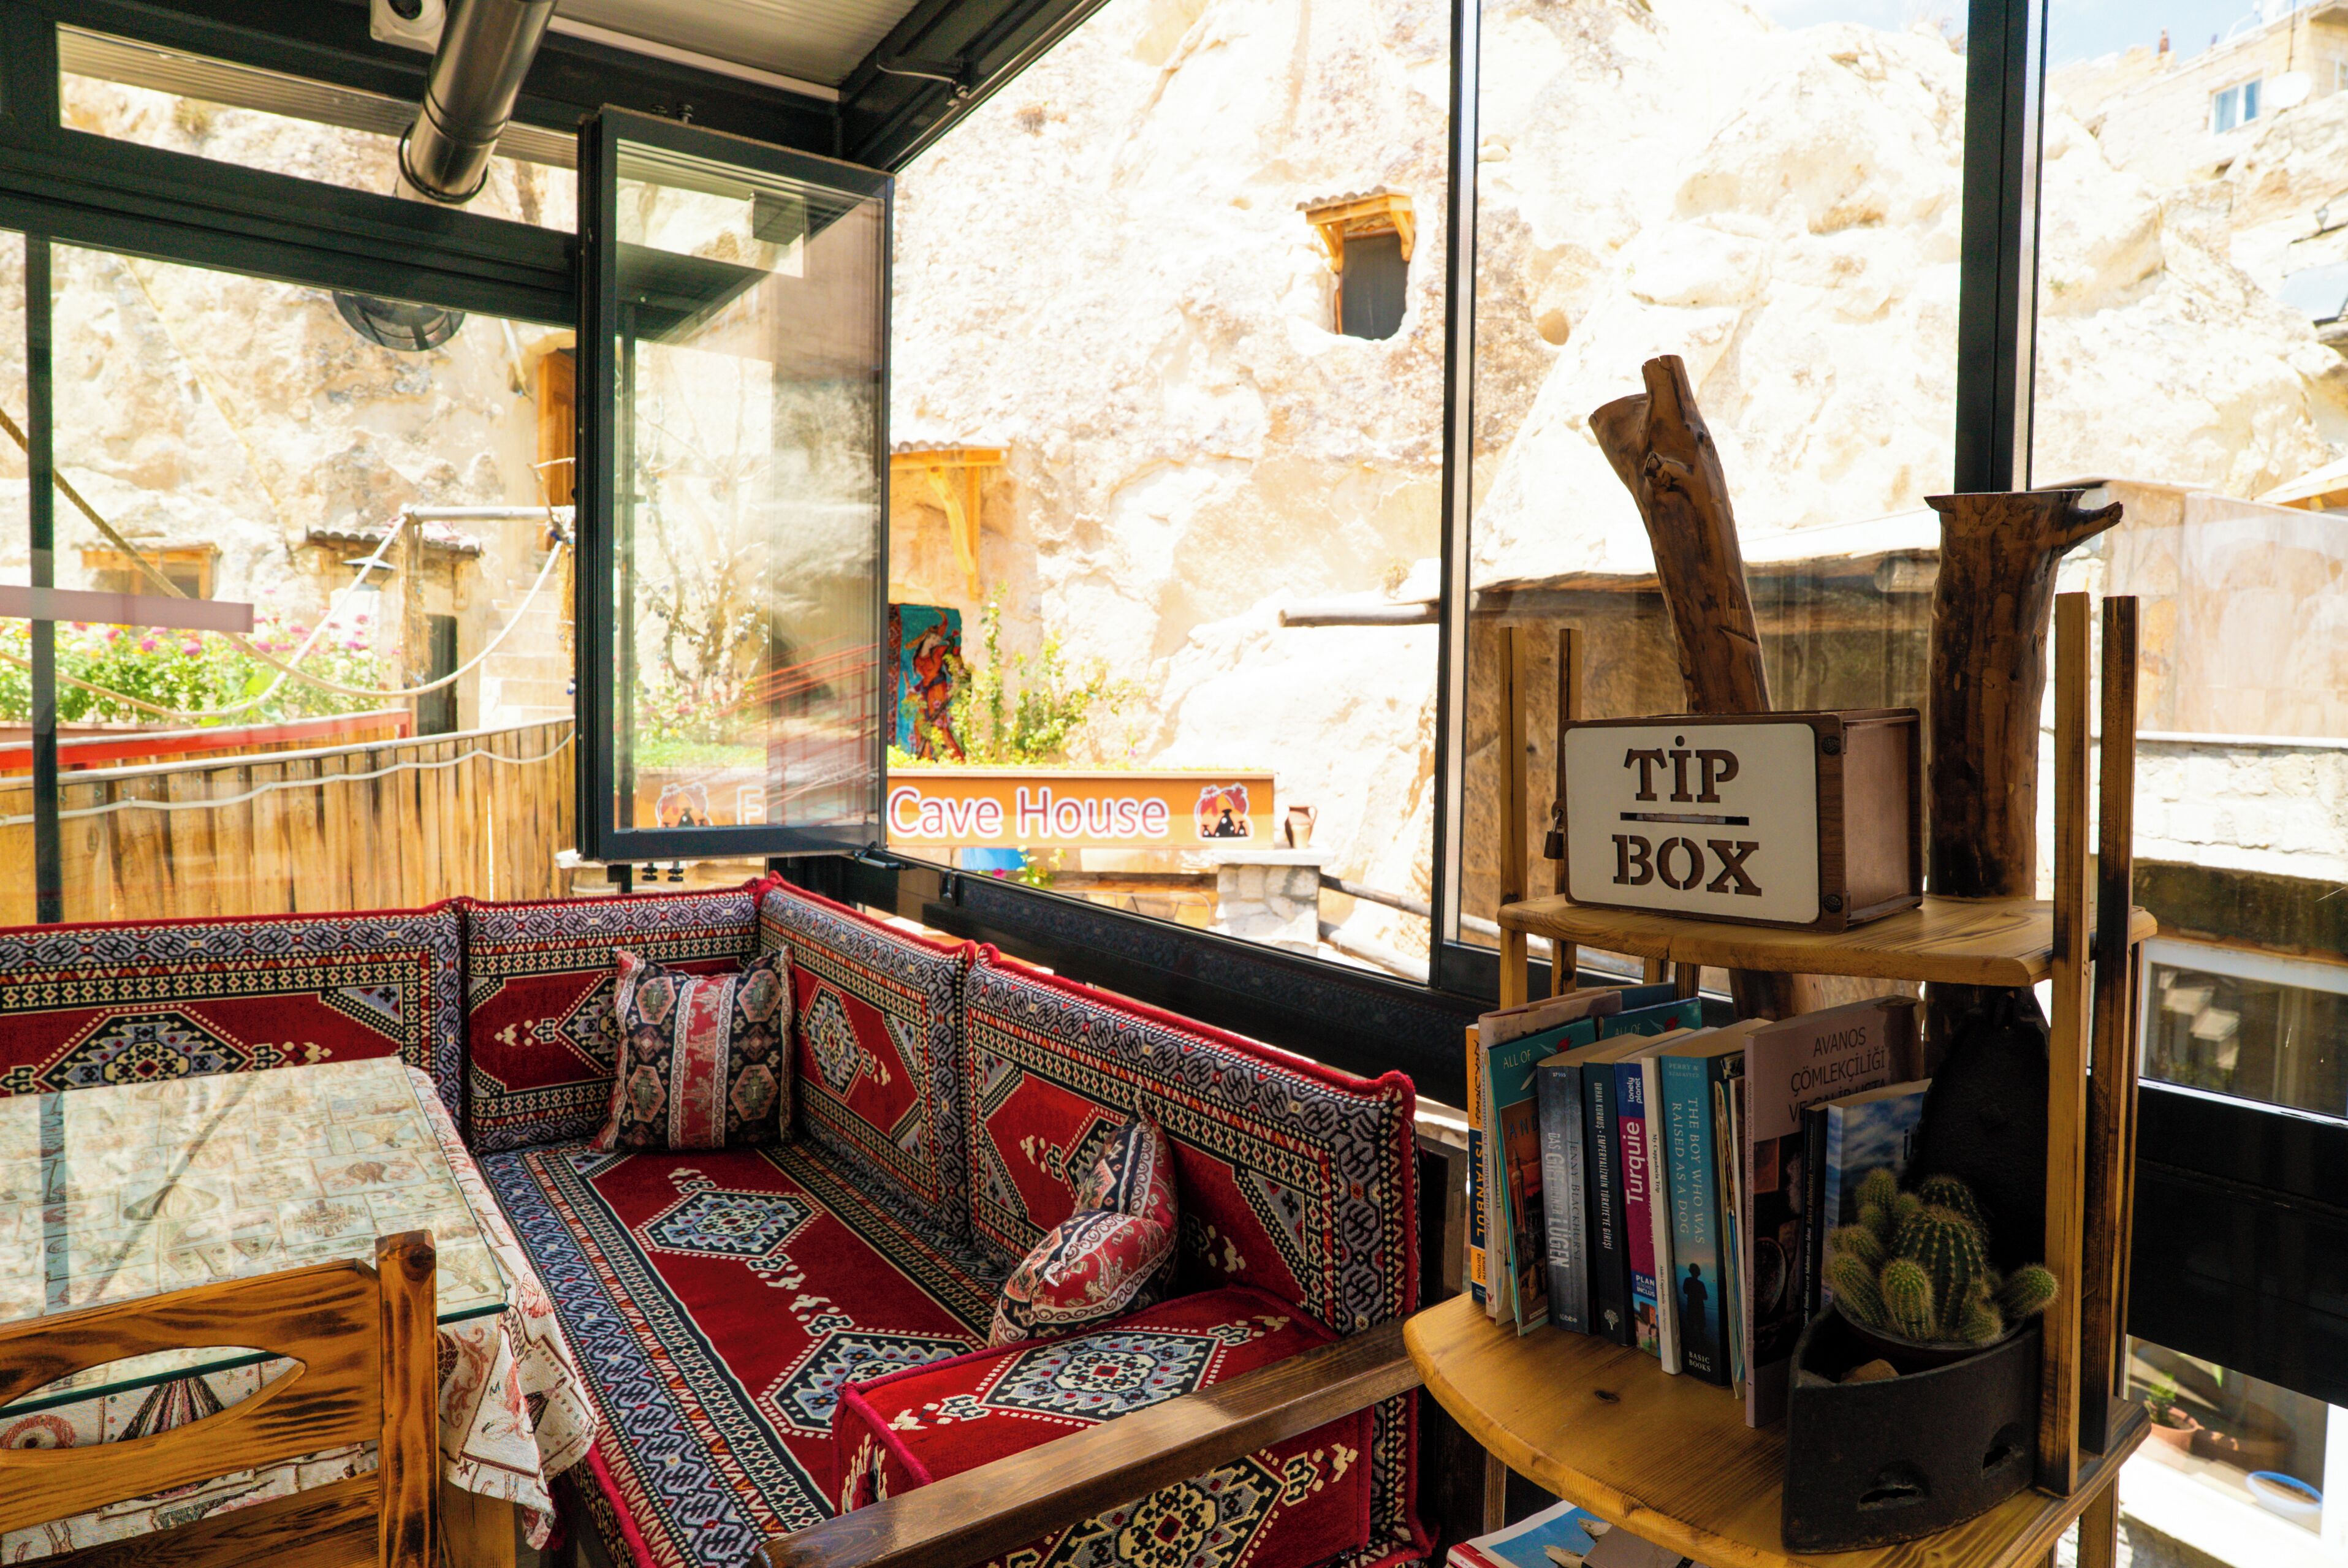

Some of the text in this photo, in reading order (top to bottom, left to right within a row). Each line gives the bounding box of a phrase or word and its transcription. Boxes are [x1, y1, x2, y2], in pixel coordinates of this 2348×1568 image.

[888, 786, 1169, 839] Cave House
[1612, 834, 1762, 897] BOX
[1631, 1023, 1641, 1034] OF
[1813, 1027, 1866, 1057] AVANOS
[1503, 1050, 1531, 1069] ALL OF
[1791, 1046, 1885, 1097] ÇÖMLEKÇİLİĞİ
[1594, 1082, 1605, 1129] ORHAN KURMUŞ
[1548, 1132, 1561, 1149] DAS
[1652, 1133, 1657, 1143] My
[1546, 1153, 1565, 1183] GIFT
[1597, 1134, 1610, 1188] EMPERYALİZMİN
[1622, 1121, 1646, 1205] Turquie
[1672, 1102, 1689, 1234] RAISED AS A DOG
[1687, 1097, 1705, 1244] THE BOY WHO WAS
[1568, 1140, 1581, 1262] JENNY BLACKHURST
[1548, 1218, 1571, 1268] LÜGEN
[1636, 1274, 1655, 1285] PLAN
[1636, 1286, 1655, 1297] INCLUS
[1689, 1351, 1710, 1364] BASIC
[1689, 1358, 1711, 1373] BOOKS
